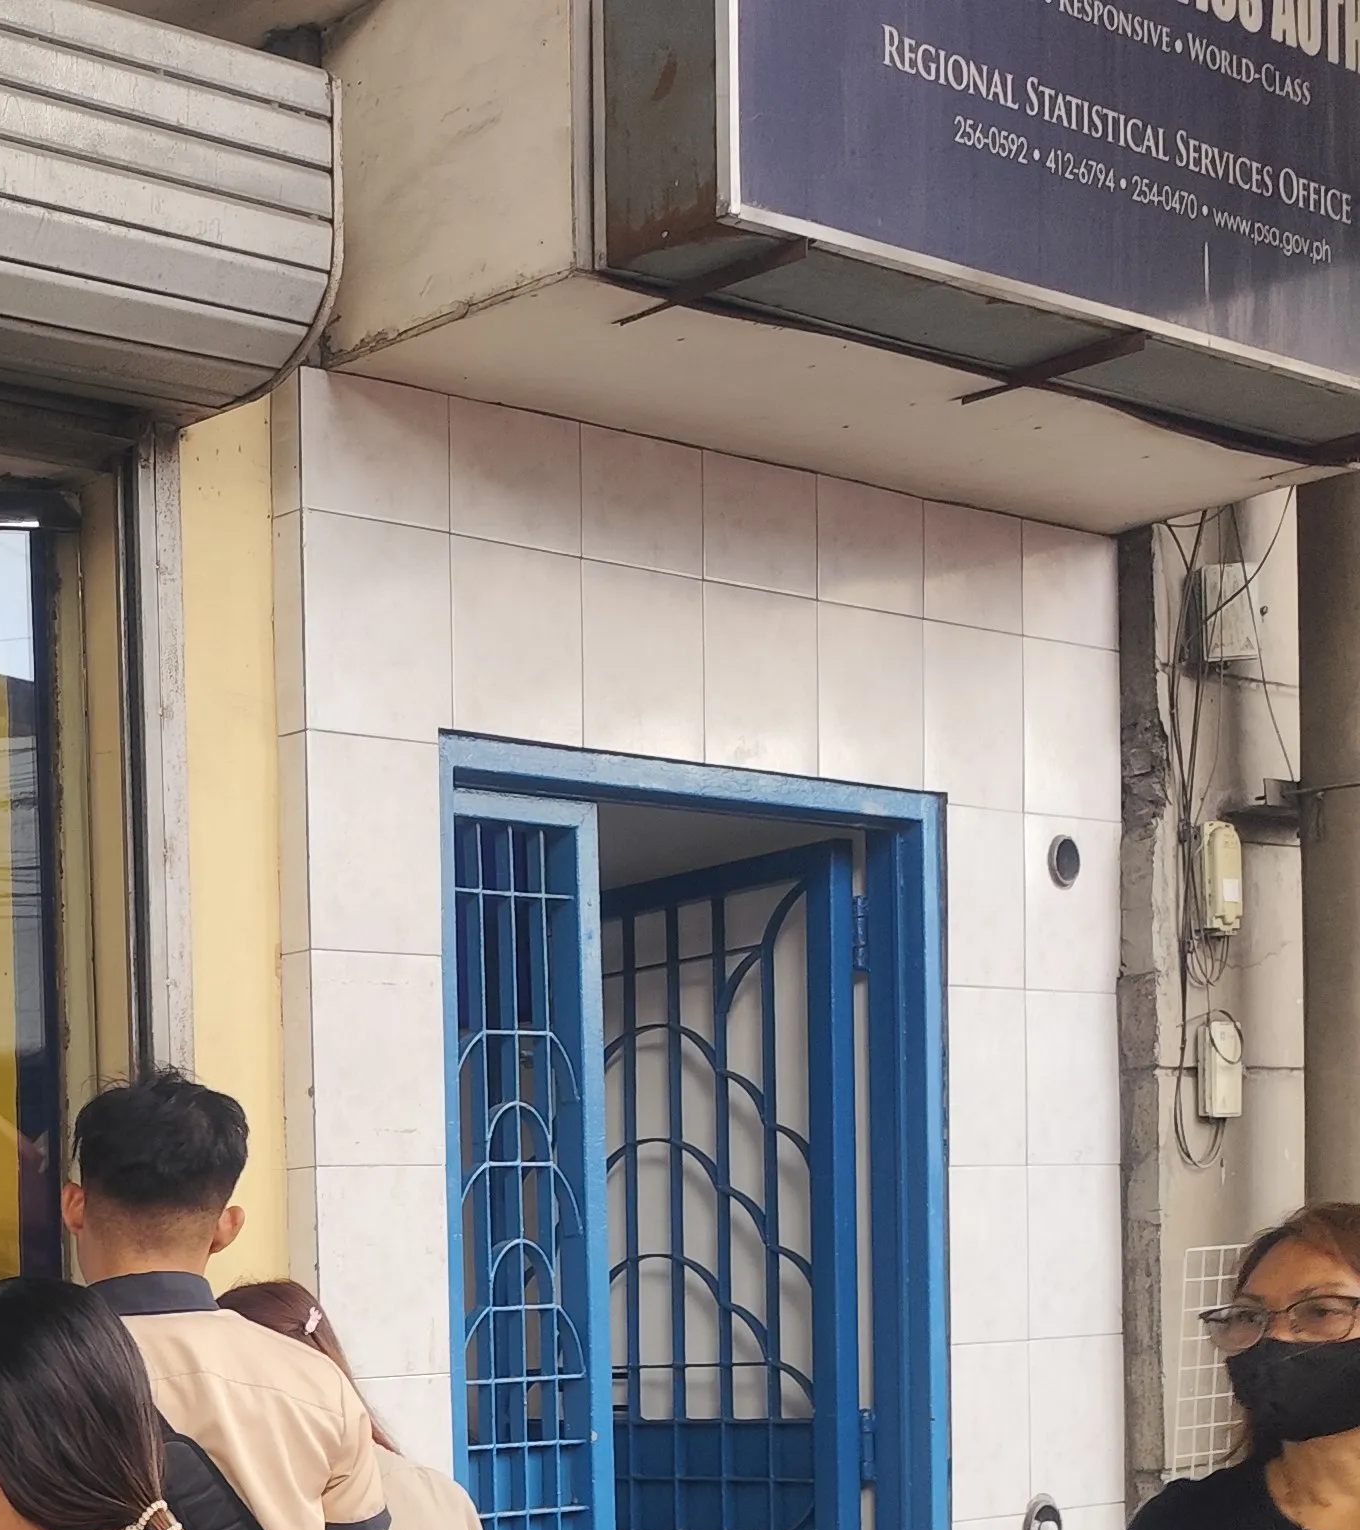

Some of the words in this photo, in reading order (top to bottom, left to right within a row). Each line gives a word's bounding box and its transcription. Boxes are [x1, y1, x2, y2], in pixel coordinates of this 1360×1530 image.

[882, 24, 1019, 111] REGIONAL
[1026, 77, 1169, 162] STATISTICAL
[1176, 130, 1273, 197] SERVICES
[1280, 167, 1352, 225] OFFICE
[1059, 0, 1171, 53] RESPONSIVE
[1187, 33, 1311, 106] WORLD-CLASS
[954, 116, 1029, 164] 256-0592
[1046, 148, 1115, 192] 412-6794
[1132, 177, 1198, 219] 254-0470
[1213, 208, 1332, 264] www.psa.gov.ph
